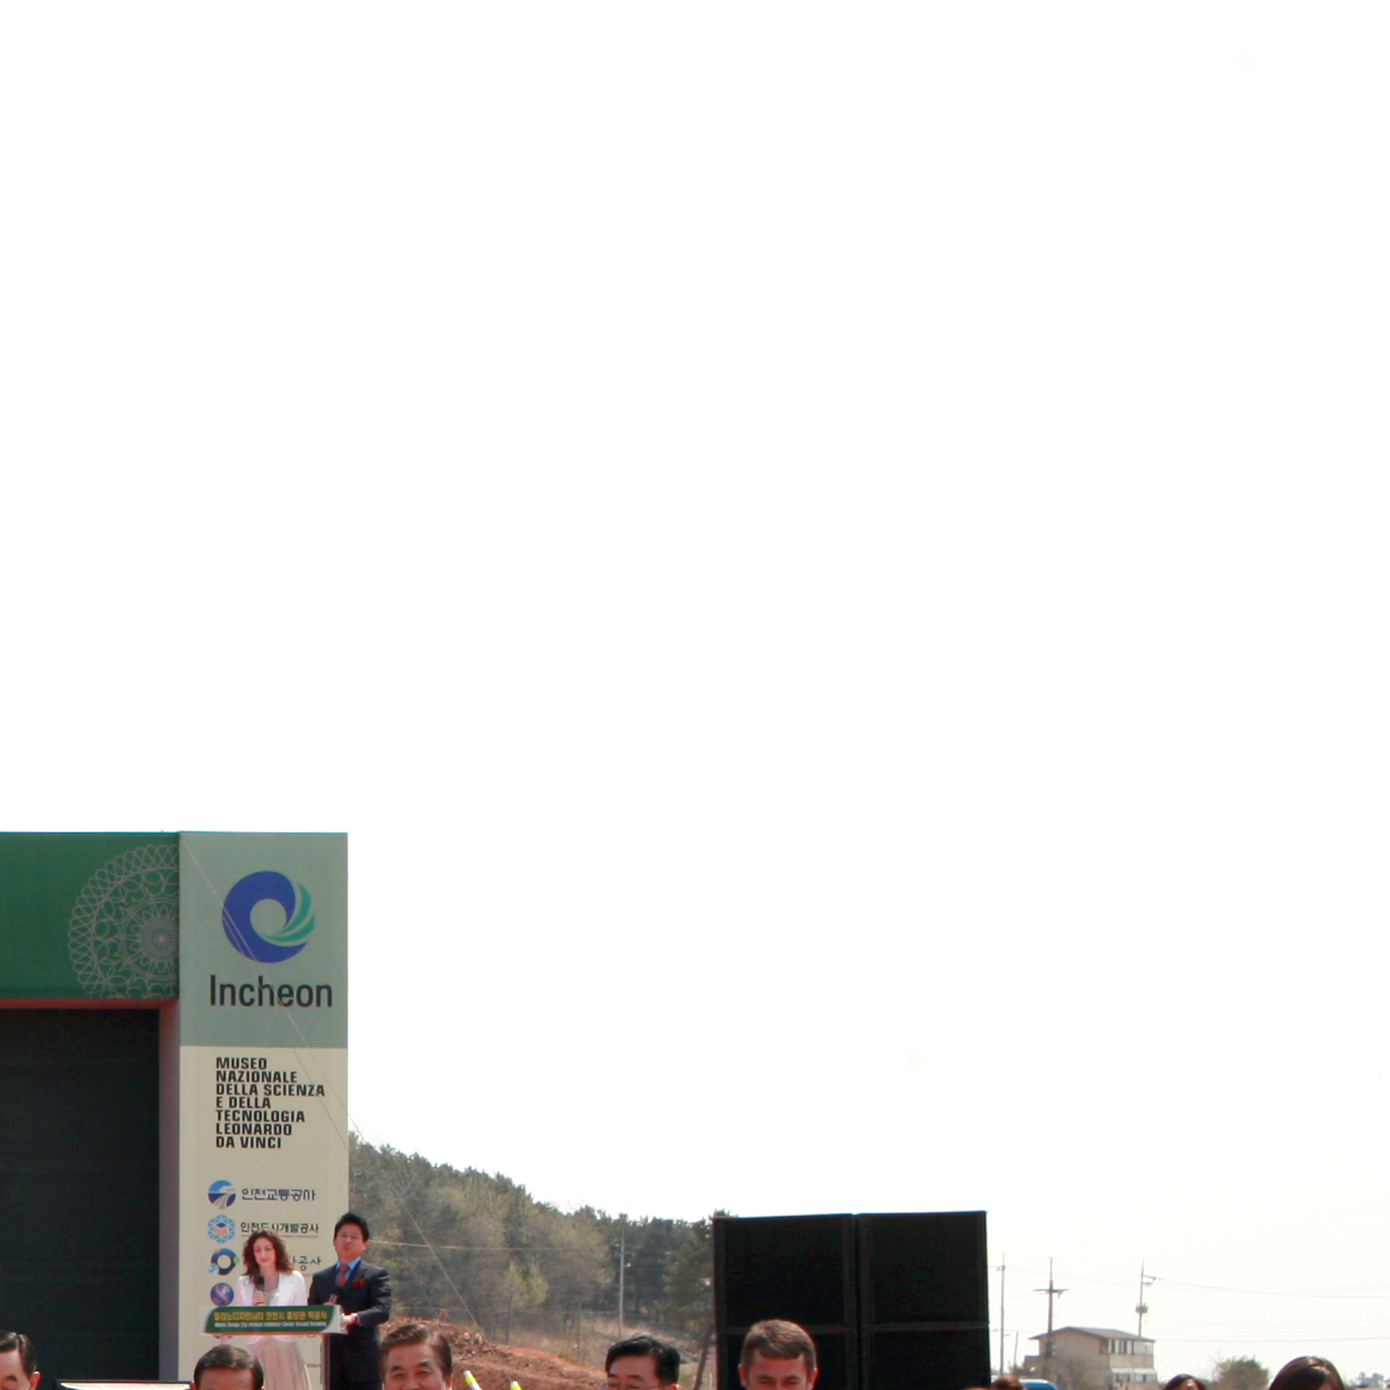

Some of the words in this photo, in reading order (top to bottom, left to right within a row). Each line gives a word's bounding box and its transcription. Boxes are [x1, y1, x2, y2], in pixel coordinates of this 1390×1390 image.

[210, 974, 333, 1008] Incheon
[216, 1057, 267, 1069] MUSEO
[216, 1070, 297, 1083] NAZIONALE
[216, 1083, 258, 1096] DELLA
[263, 1084, 325, 1097] SCIENZA
[216, 1096, 223, 1109] E
[229, 1096, 271, 1109] DELLA
[216, 1109, 305, 1122] TECNOLOGIA
[216, 1122, 292, 1136] LEONARDO
[216, 1136, 235, 1148] DA
[240, 1136, 281, 1149] VINCI
[241, 1187, 317, 1202] 인천교통공사
